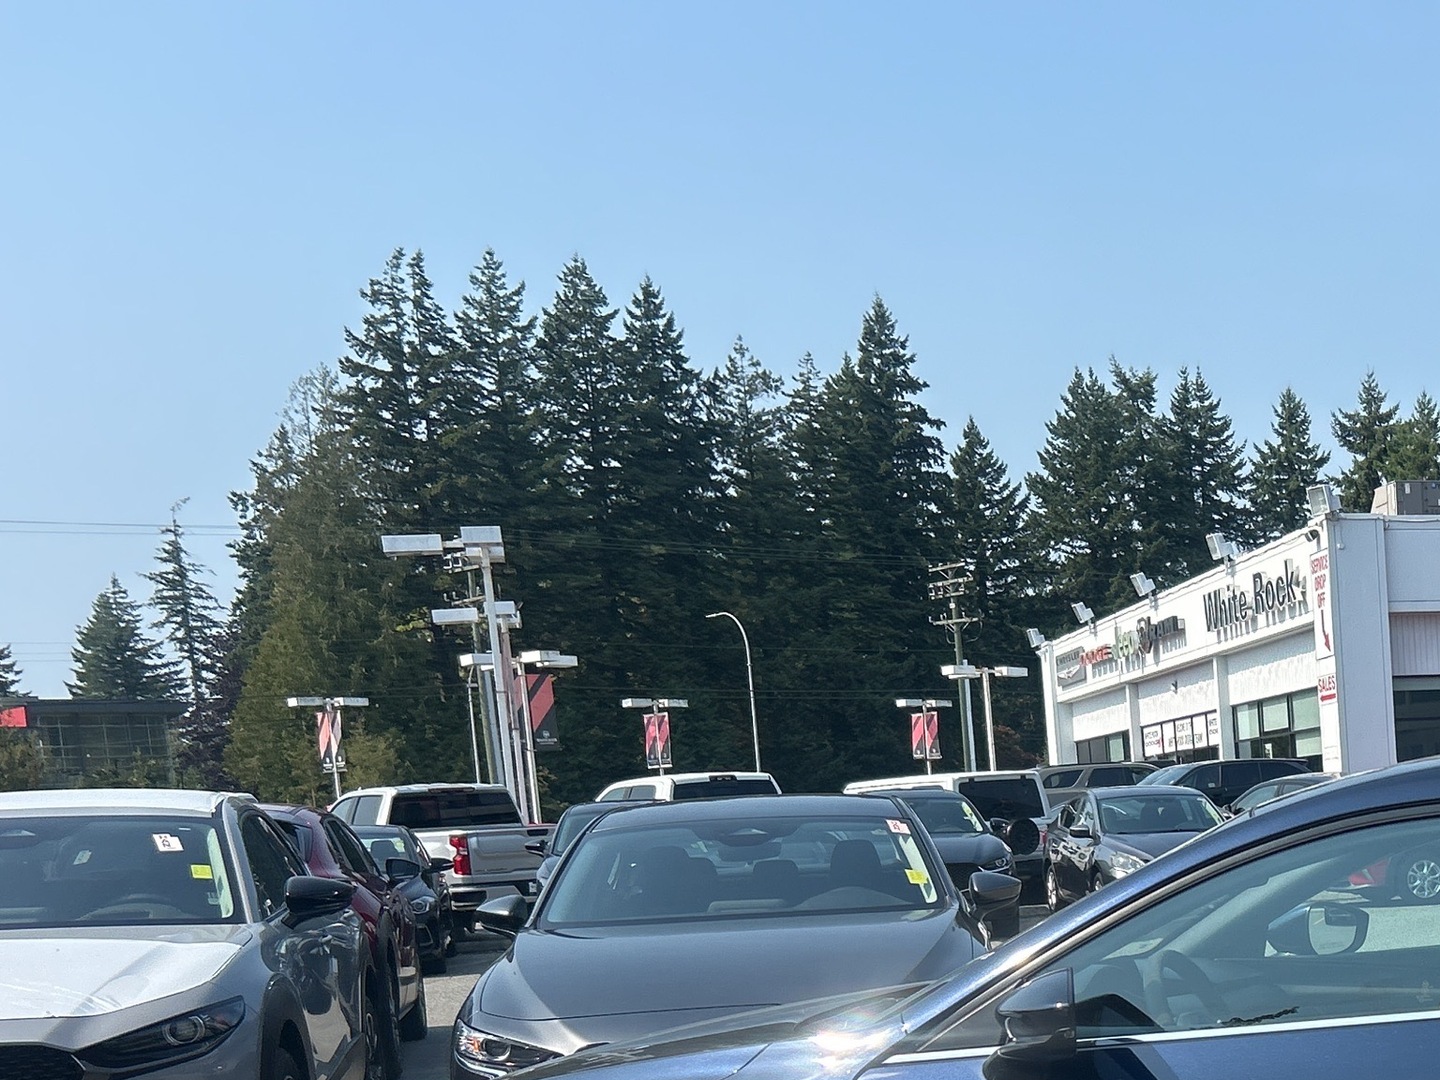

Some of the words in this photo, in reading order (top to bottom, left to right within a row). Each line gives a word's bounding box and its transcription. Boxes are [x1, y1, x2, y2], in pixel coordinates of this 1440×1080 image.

[1310, 554, 1329, 575] SERVICE
[1314, 573, 1326, 592] DROP
[1203, 585, 1248, 632] White
[1252, 559, 1297, 615] Rock
[1317, 591, 1326, 609] OFF
[1317, 674, 1336, 693] SALES
